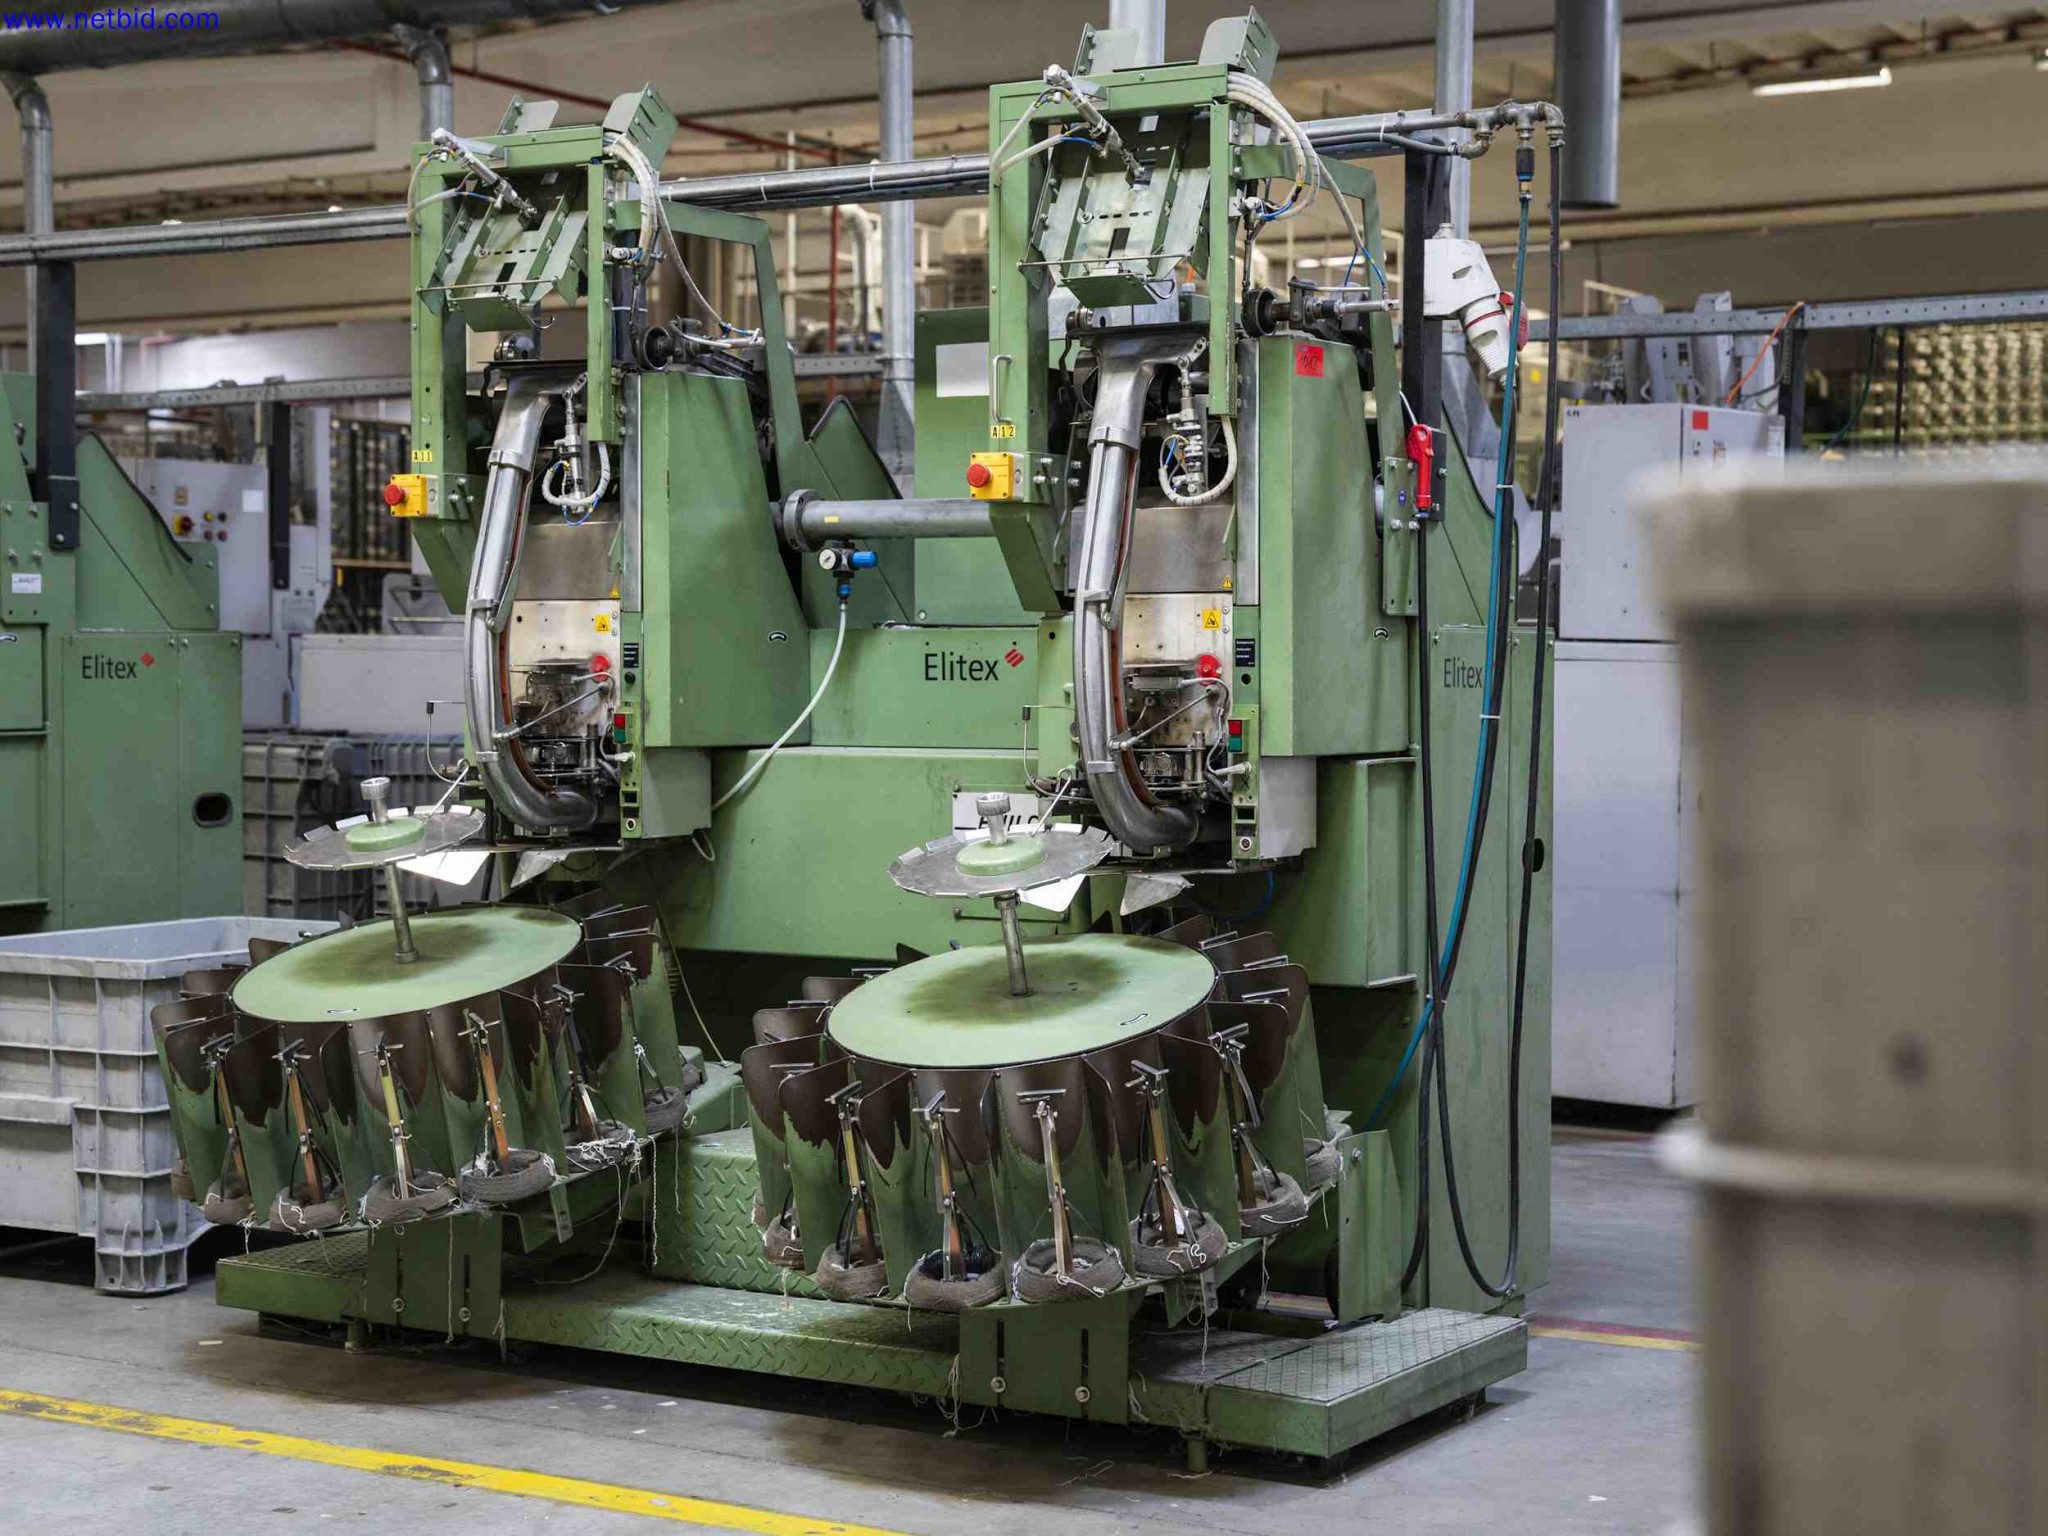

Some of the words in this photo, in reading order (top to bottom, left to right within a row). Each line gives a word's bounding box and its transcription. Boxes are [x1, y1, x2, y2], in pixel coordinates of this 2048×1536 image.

[992, 426, 1014, 437] A12
[414, 451, 431, 461] A11
[81, 655, 137, 679] Elitex
[924, 651, 999, 681] Elitex
[1443, 657, 1483, 689] Elitex
